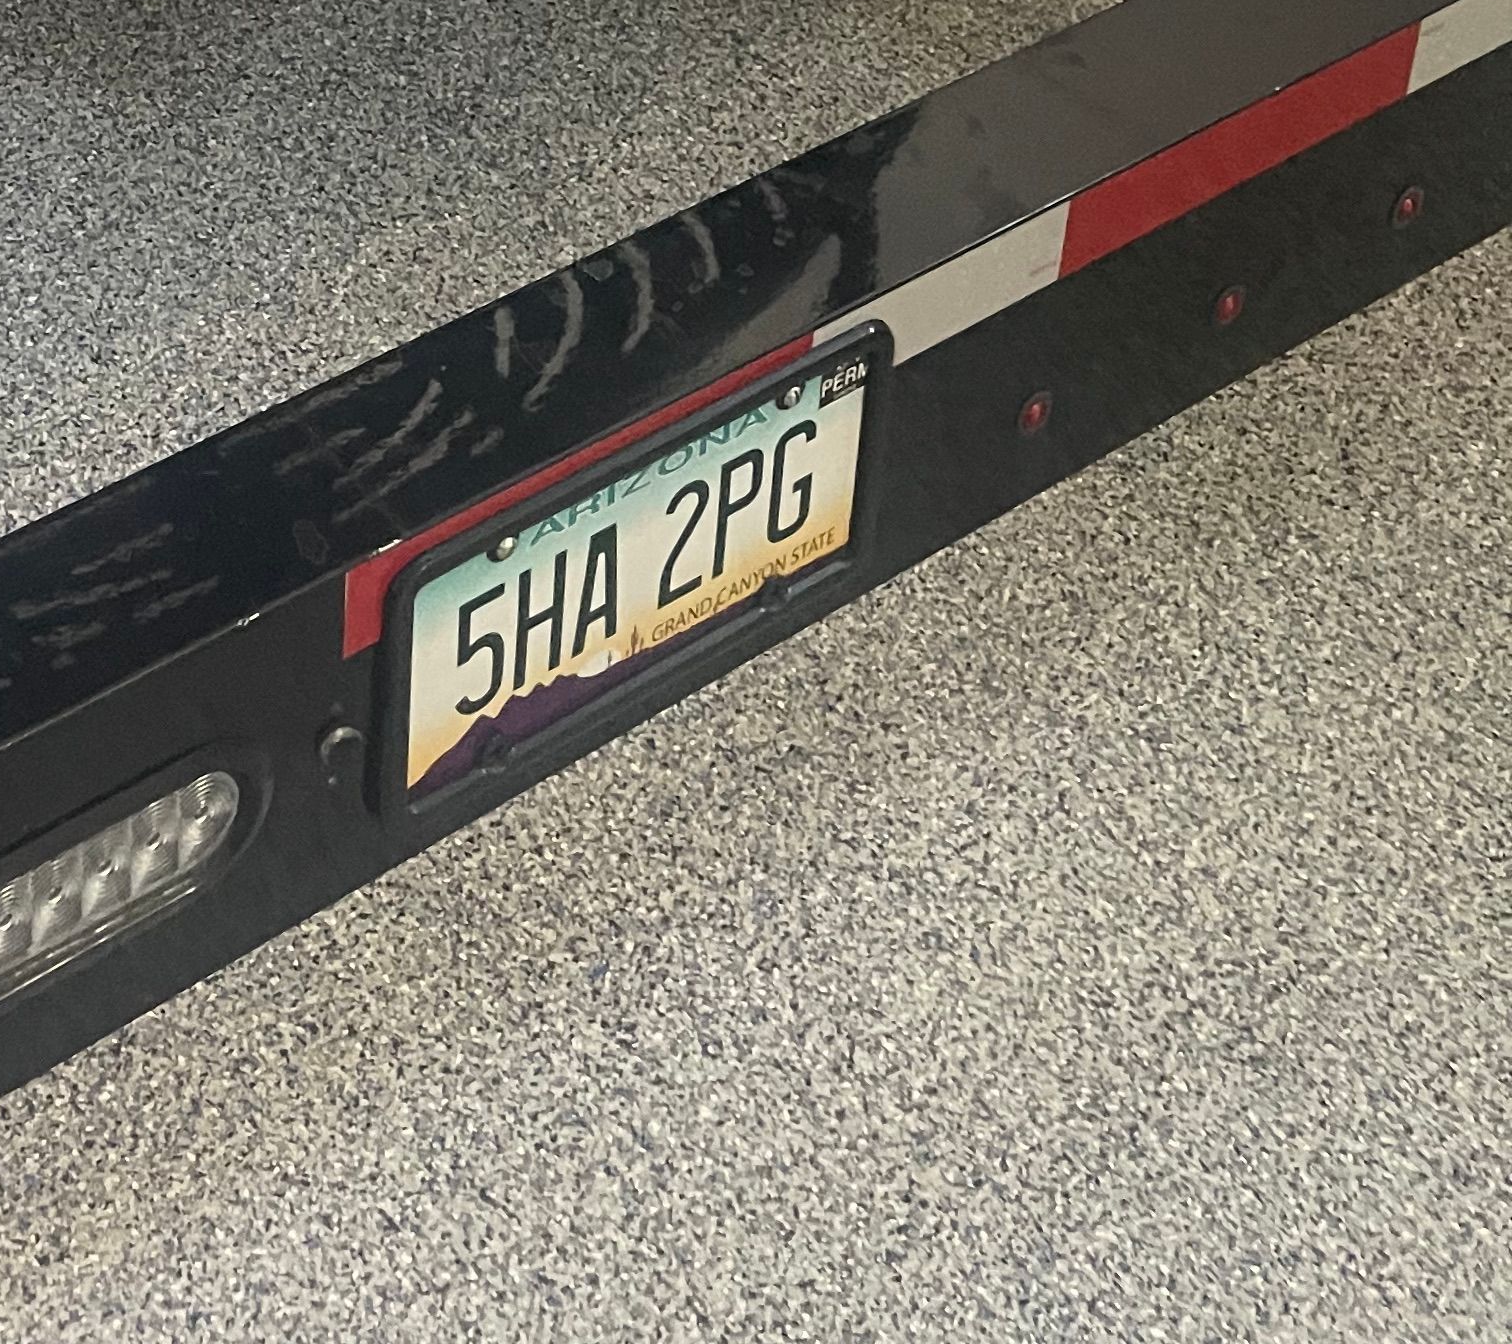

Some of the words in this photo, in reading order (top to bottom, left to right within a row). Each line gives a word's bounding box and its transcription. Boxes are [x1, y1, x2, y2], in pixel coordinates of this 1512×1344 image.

[454, 522, 618, 716] 5HA
[657, 419, 818, 609] 2PG
[651, 596, 714, 643] GRAND
[716, 553, 789, 606] CANYON
[790, 526, 836, 566] STATE
